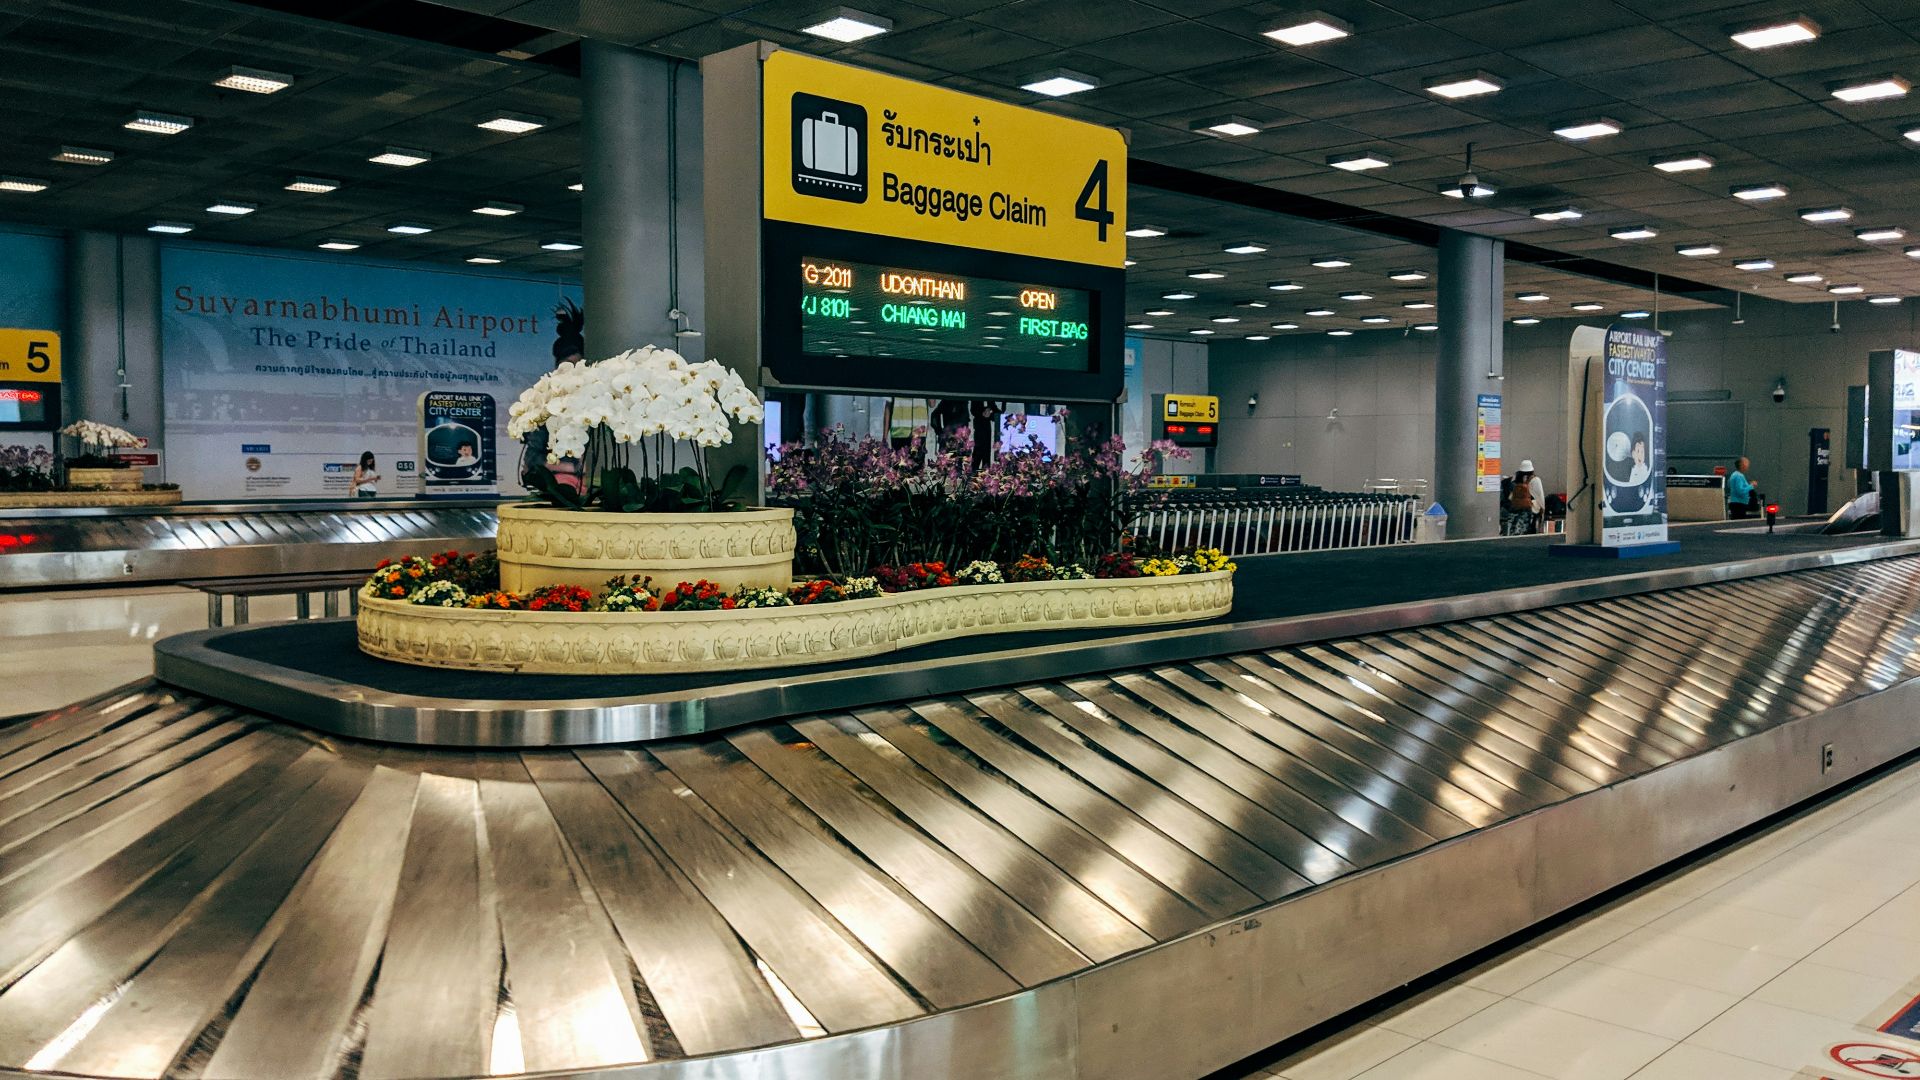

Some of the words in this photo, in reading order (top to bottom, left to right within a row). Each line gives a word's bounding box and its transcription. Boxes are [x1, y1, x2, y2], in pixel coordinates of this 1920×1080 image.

[881, 109, 991, 166] รับกระเป๋า
[883, 172, 982, 221] Baggage
[989, 192, 1046, 227] Claim
[1075, 159, 1114, 242] 4
[801, 264, 819, 283] G
[823, 266, 851, 288] 2011
[881, 273, 964, 300] UDONTHANI
[1020, 290, 1055, 310] OPEN
[174, 285, 420, 327] Suvarnabhumi
[433, 305, 539, 339] Airport
[821, 297, 849, 318] 8101
[881, 303, 938, 327] CHIANG
[941, 309, 965, 328] MAI
[1020, 317, 1059, 337] FIRST
[1061, 321, 1088, 339] BAG
[251, 326, 297, 348] The
[307, 330, 371, 351] Pride
[381, 336, 396, 349] of
[400, 336, 496, 358] Thailand
[1609, 330, 1632, 344] AIRPORT
[1632, 333, 1643, 347] RAIL
[1644, 335, 1656, 348] LINK
[1609, 342, 1633, 359] FASTEST
[1633, 347, 1647, 361] WAY
[1647, 349, 1656, 362] TO
[27, 341, 50, 373] 5
[1608, 358, 1626, 377] CITY
[1626, 360, 1655, 379] CENTER
[429, 400, 456, 408] FASTEST
[429, 407, 448, 415] CITY
[449, 407, 482, 416] CENTER
[1208, 401, 1216, 418] 5
